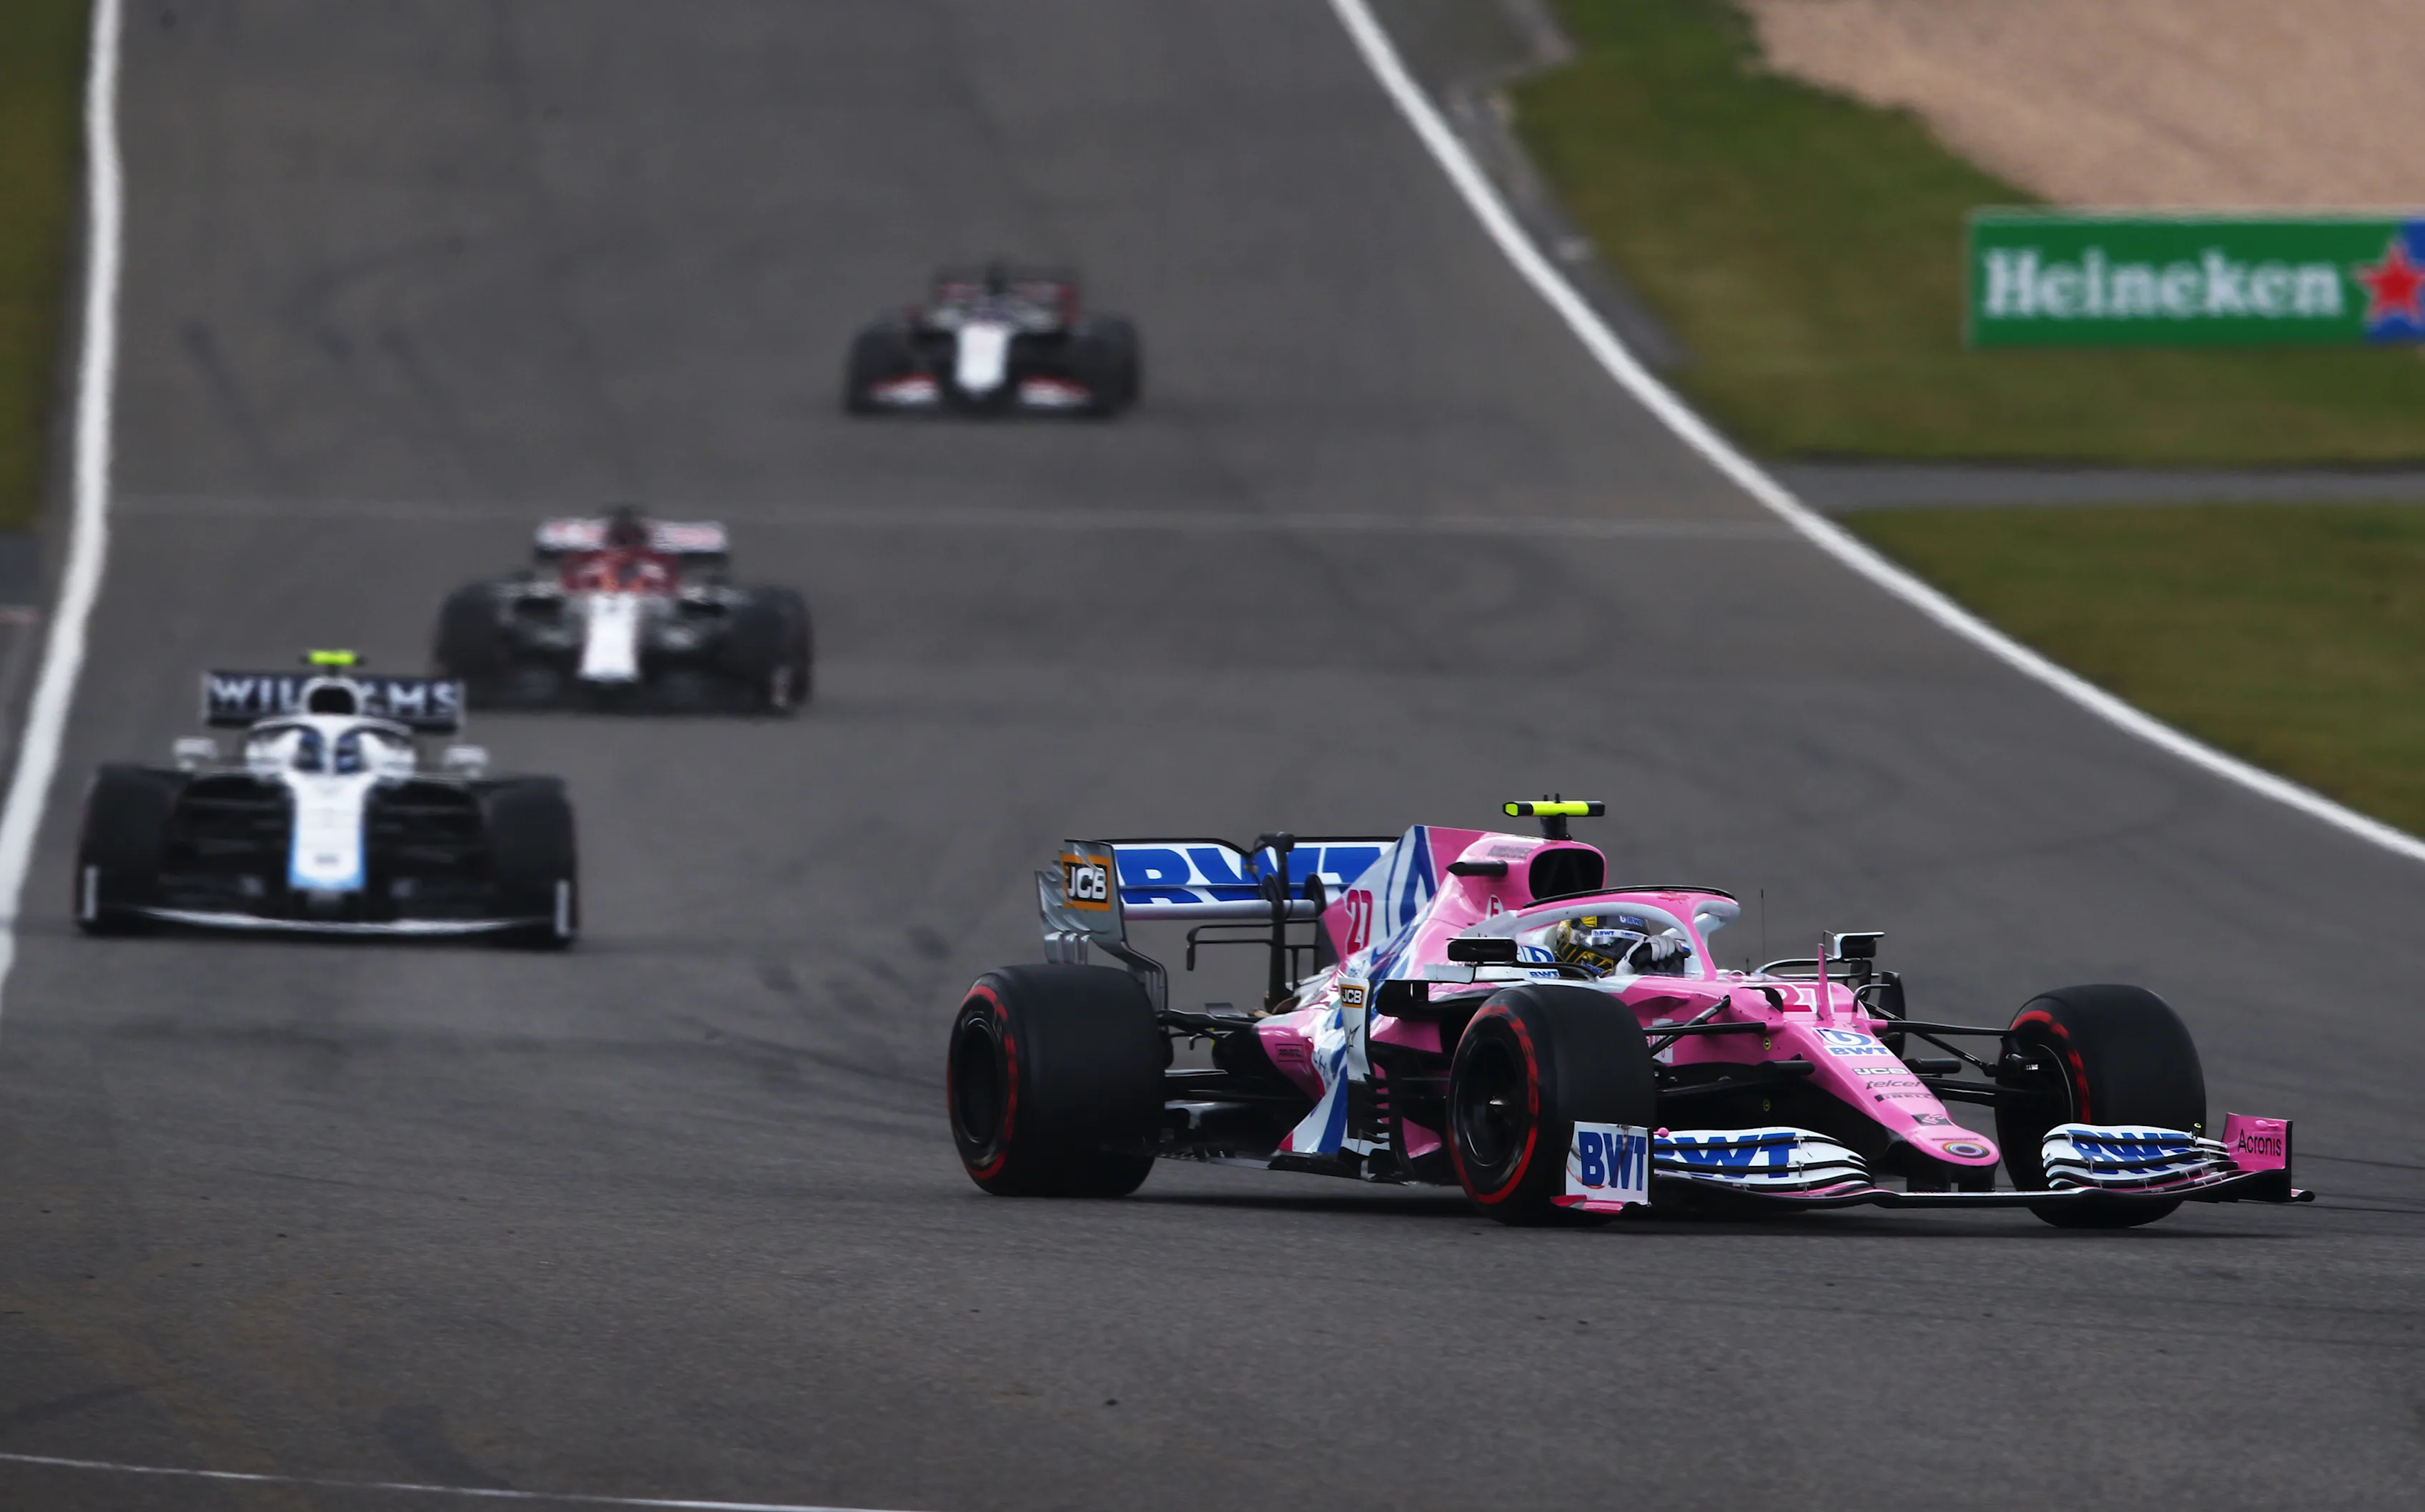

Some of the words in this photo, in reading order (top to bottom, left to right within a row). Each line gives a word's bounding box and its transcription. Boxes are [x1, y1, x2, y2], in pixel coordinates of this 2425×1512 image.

[1983, 247, 2343, 317] Heineken
[211, 678, 460, 715] WILAMS
[1067, 866, 1107, 900] JCB
[1117, 846, 1383, 904] BWT
[1347, 889, 1373, 955] 27
[1342, 989, 1363, 1004] JCB
[1829, 1047, 1888, 1055] BWT
[1578, 1131, 1646, 1192] BWT
[2066, 1130, 2192, 1175] BWT
[2238, 1129, 2282, 1157] Acronis
